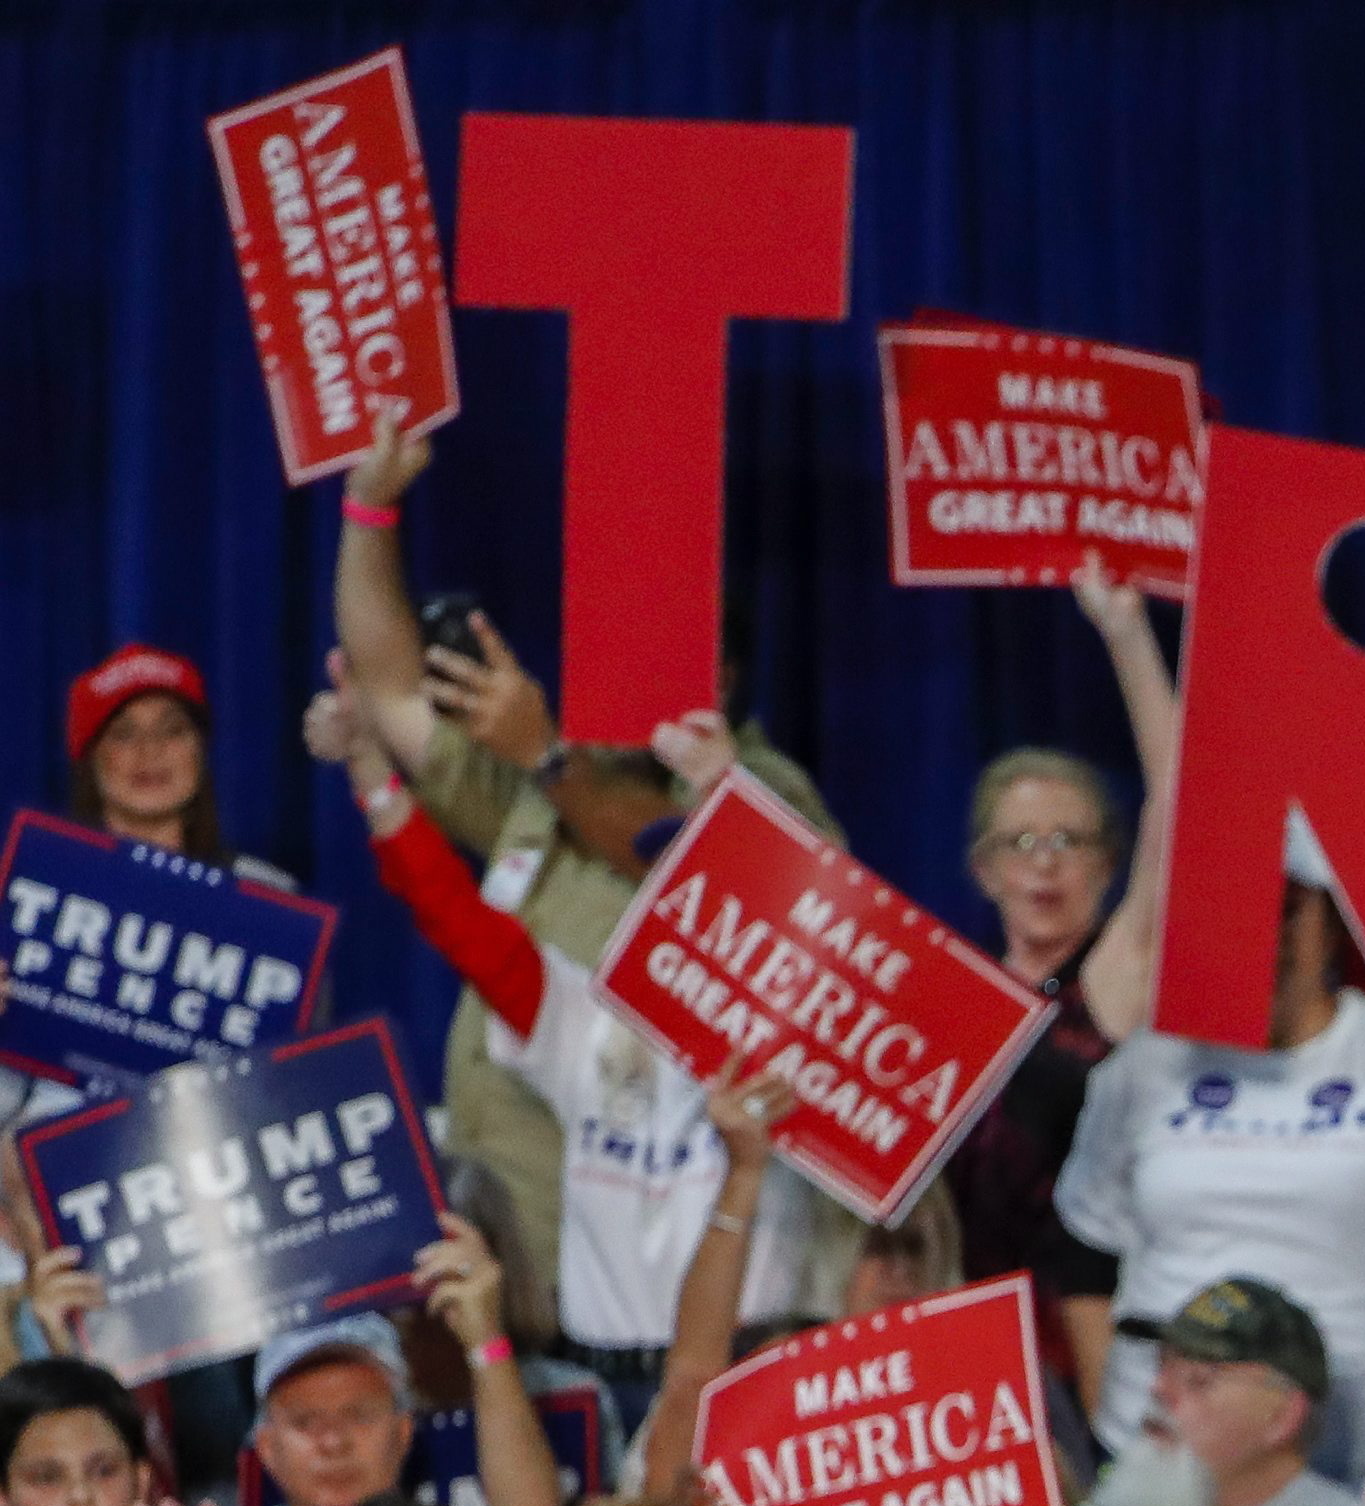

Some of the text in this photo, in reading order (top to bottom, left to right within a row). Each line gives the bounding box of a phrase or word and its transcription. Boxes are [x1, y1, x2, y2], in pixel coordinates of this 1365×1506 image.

[259, 134, 360, 436] GREAT AGAIN
[1000, 372, 1106, 420] MAKE
[903, 420, 1206, 504] AMERICA
[928, 490, 1069, 535] GREAT
[8, 876, 301, 1010] TRUMP
[11, 936, 261, 1049] PENCE
[653, 869, 962, 1126] AMERICA
[787, 889, 912, 994] MAKE
[645, 941, 911, 1155] GREAT AGAIN
[57, 1090, 397, 1243] TRUMP
[101, 1153, 383, 1276] PENCE
[791, 1350, 915, 1418] MAKE
